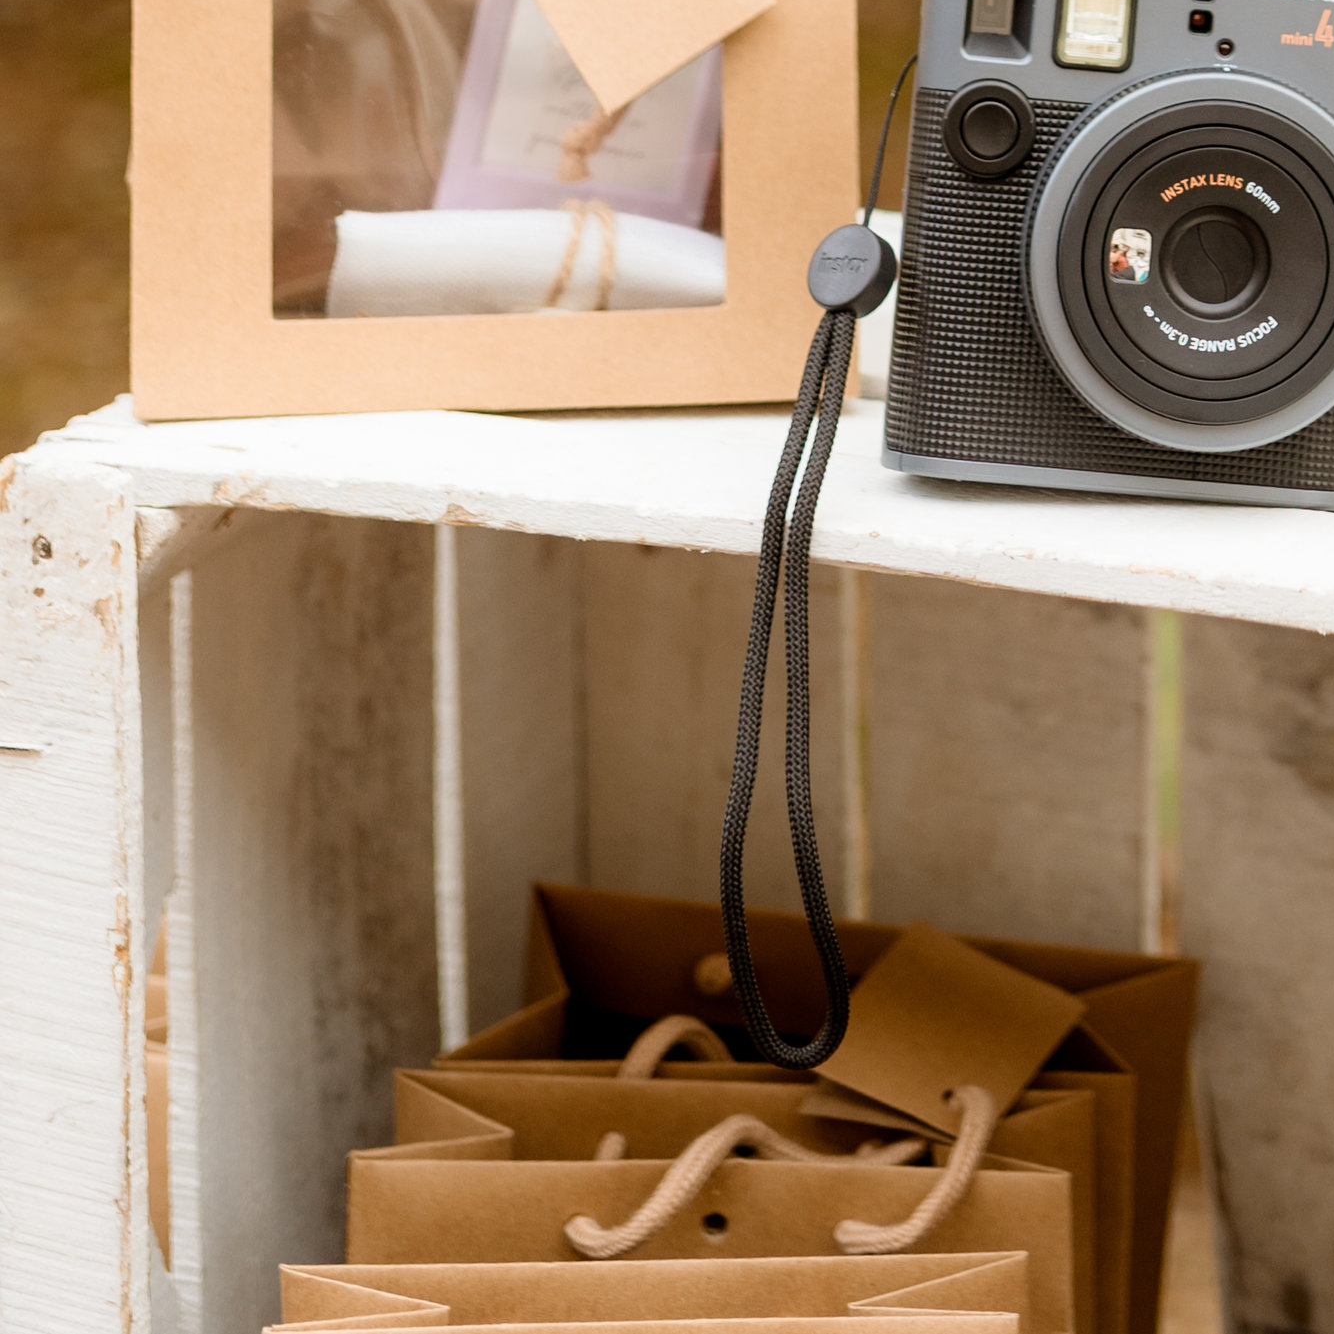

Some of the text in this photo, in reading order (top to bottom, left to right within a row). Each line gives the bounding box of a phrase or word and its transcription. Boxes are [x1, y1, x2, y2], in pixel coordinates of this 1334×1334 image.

[1280, 31, 1314, 47] mini
[1160, 173, 1281, 214] INSTAX LENS 60mm
[1159, 320, 1189, 347] 0.3m
[1188, 337, 1237, 353] RANGE
[1237, 315, 1279, 348] FOCUS
